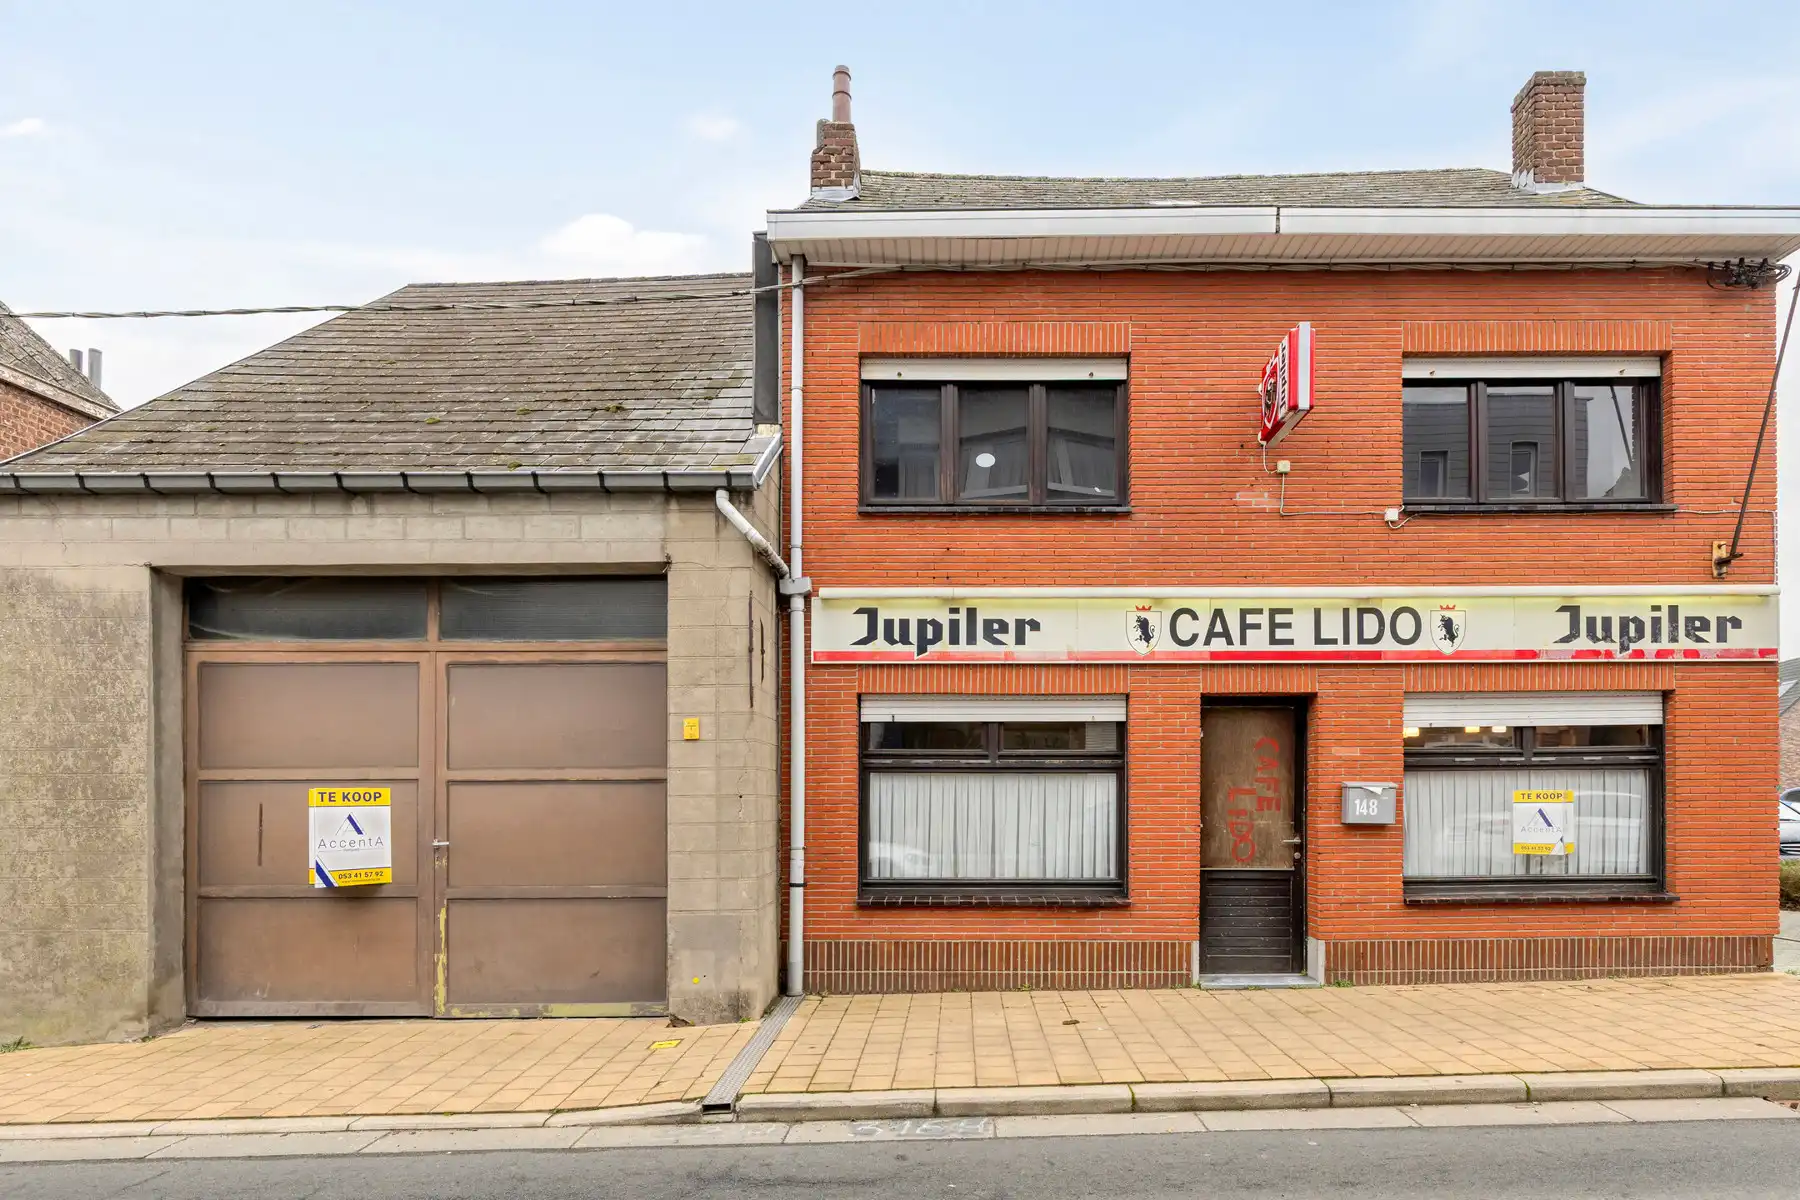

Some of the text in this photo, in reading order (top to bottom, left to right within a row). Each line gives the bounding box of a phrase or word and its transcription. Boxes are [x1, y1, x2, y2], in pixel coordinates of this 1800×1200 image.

[850, 607, 1041, 657] Jupiler
[1169, 606, 1422, 647] CAFE LIDO
[1553, 604, 1742, 654] Jupiler
[1254, 737, 1281, 812] CAFE
[317, 791, 382, 802] TE KOOP
[1354, 798, 1378, 816] 148
[1520, 792, 1563, 800] TE KOOP
[1227, 787, 1257, 862] LIDO
[317, 837, 384, 849] AccentA
[364, 870, 373, 878] 57
